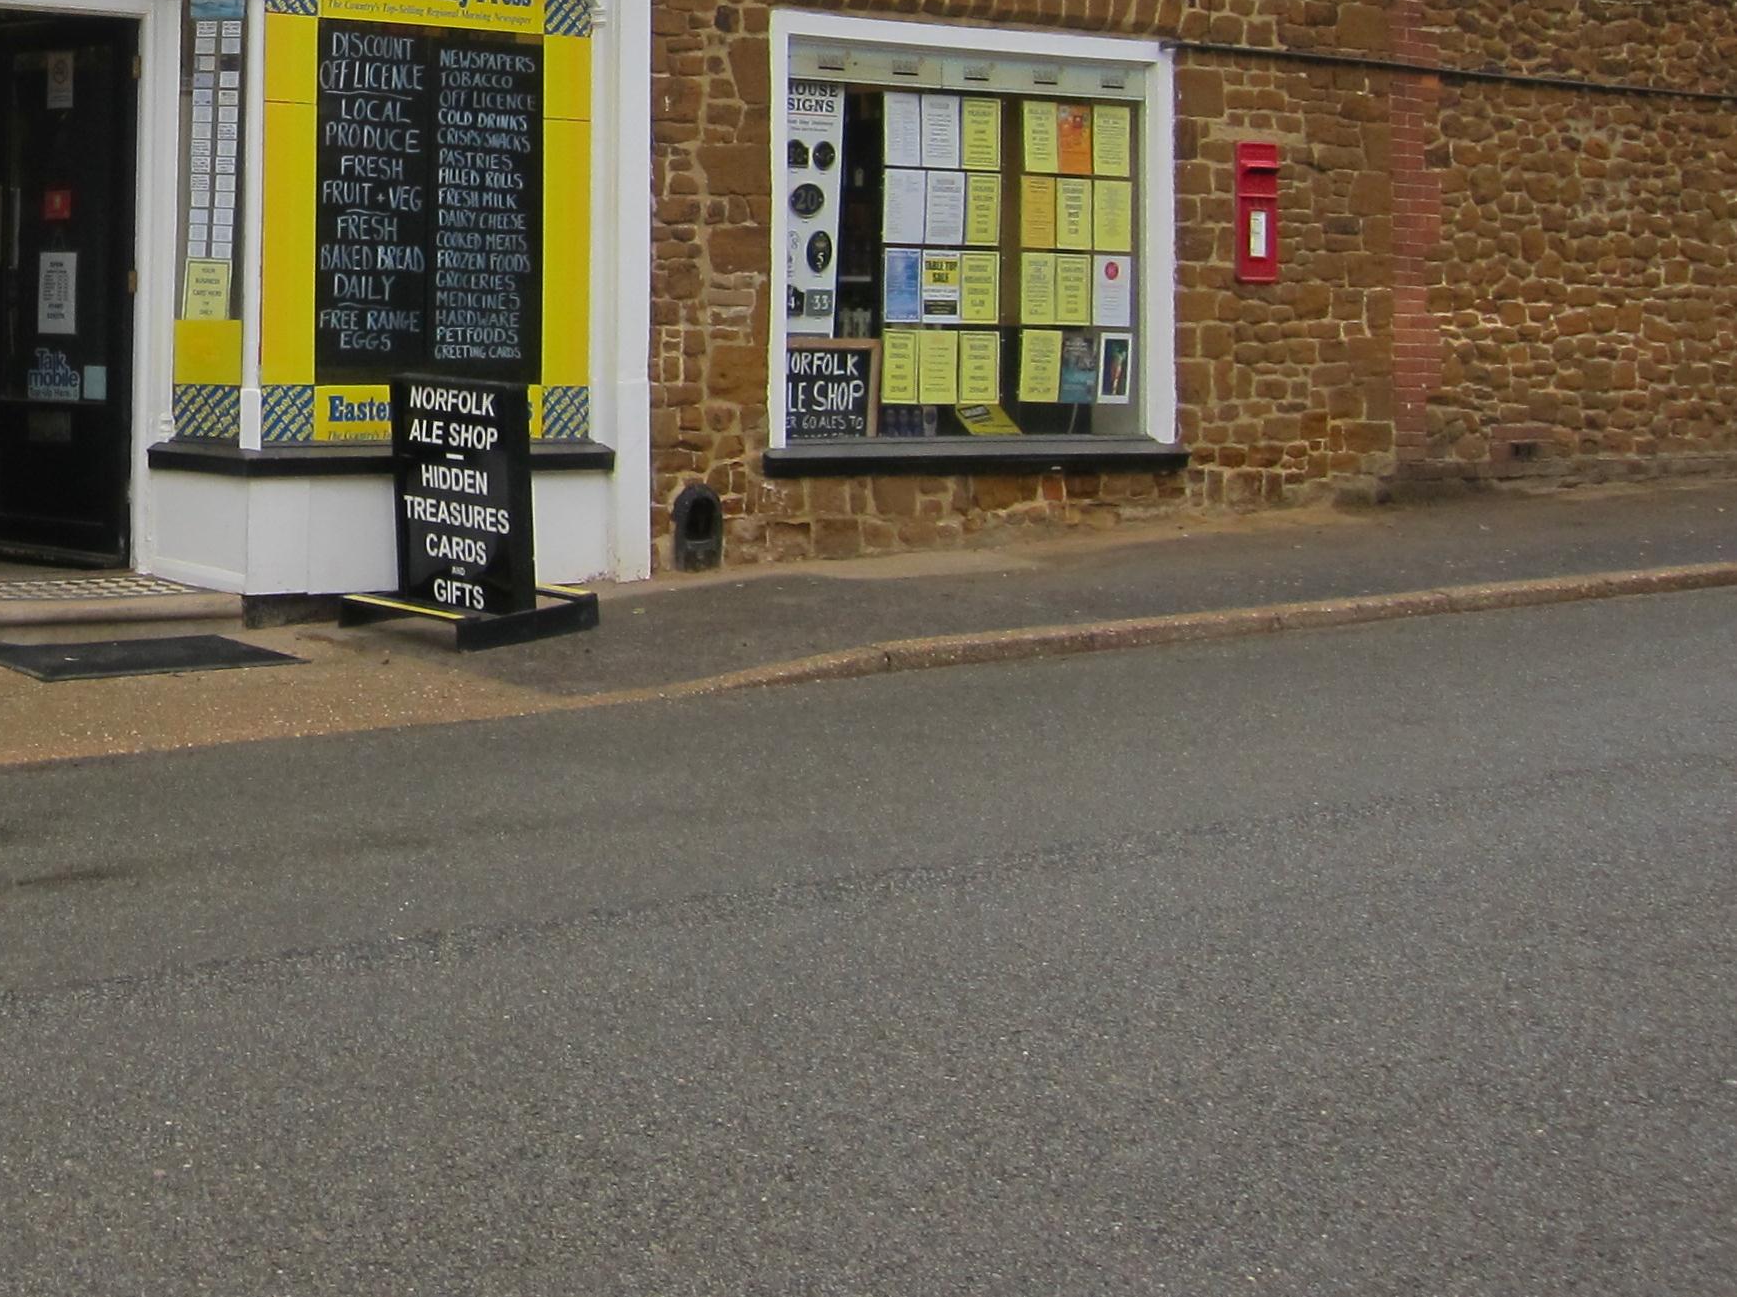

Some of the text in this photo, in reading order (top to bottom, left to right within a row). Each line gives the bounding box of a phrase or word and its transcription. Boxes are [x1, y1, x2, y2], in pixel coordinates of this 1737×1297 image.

[332, 32, 414, 60] DISCOUNT
[439, 49, 535, 73] NEWSPAPERS
[319, 60, 424, 90] OFF LICENCE
[441, 70, 513, 89] TOBACCO
[341, 98, 411, 123] LOCAL
[439, 89, 536, 111] OFF LICENCE
[787, 97, 835, 113] SIGNS
[438, 108, 528, 132] COLD DRINKS
[325, 121, 421, 152] PRODUCE
[341, 155, 403, 181] FRESH
[439, 147, 512, 171] PASTRIES
[438, 167, 524, 190] FILLED ROLLS
[323, 180, 373, 206] FRUIT
[389, 186, 423, 211] VEG
[438, 187, 517, 209] FRESH MILK
[337, 215, 398, 242] FRESH
[438, 208, 527, 230] DAIRY CHEESE
[436, 230, 527, 251] COOKED MEATS
[320, 244, 425, 273] BAKED BREAD
[437, 249, 531, 273] FROZEN FOODS
[334, 273, 395, 301] DAILY
[436, 270, 516, 291] GROCERIES
[436, 290, 520, 310] MEDICINES
[319, 309, 420, 332] FREE RANGE
[436, 309, 520, 328] HARDWARE
[340, 331, 391, 352] EGGS
[434, 345, 522, 360] GREETING CARDS
[36, 349, 68, 369] Talk
[29, 368, 79, 387] mobile
[410, 385, 496, 417] NORFOLK
[812, 379, 864, 411] SHOP
[328, 394, 391, 422] Easte
[818, 415, 846, 429] ALES
[409, 418, 498, 451] ALE SHOP
[421, 464, 488, 496] HIDDEN
[404, 494, 510, 534] TREASURES
[425, 533, 487, 565] CARDS
[451, 566, 466, 576] AND
[433, 578, 485, 610] GIFTS
